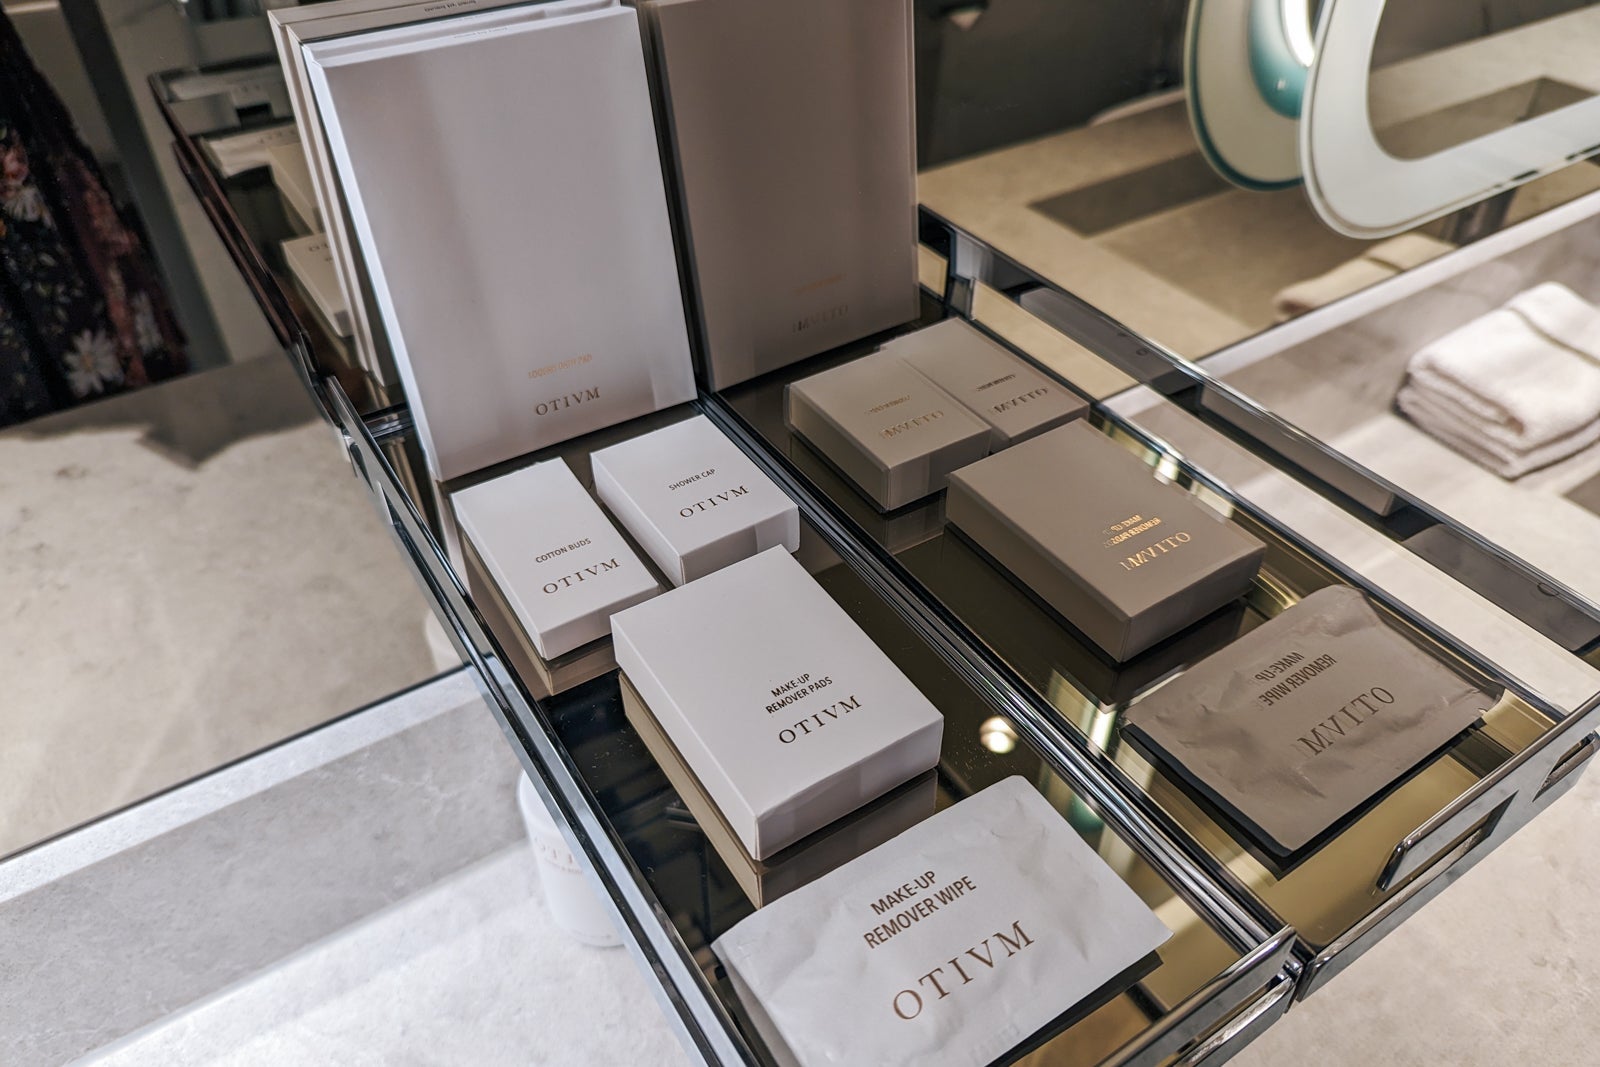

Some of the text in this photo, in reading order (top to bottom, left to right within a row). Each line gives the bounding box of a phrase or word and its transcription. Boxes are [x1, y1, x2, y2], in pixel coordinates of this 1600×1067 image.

[536, 386, 600, 416] OTIVM
[668, 468, 716, 491] SHOWER CAP
[679, 485, 749, 518] OTIVM
[535, 538, 592, 563] COTTON BUDS
[543, 558, 621, 594] OTIVM
[765, 676, 833, 714] REMOVER PADS
[770, 673, 810, 697] MAKE-UP
[778, 695, 862, 744] OTIVM
[870, 870, 936, 916] MAKE-UP
[863, 875, 977, 949] REMOVER WIPE
[893, 920, 1035, 1020] OTIVM
